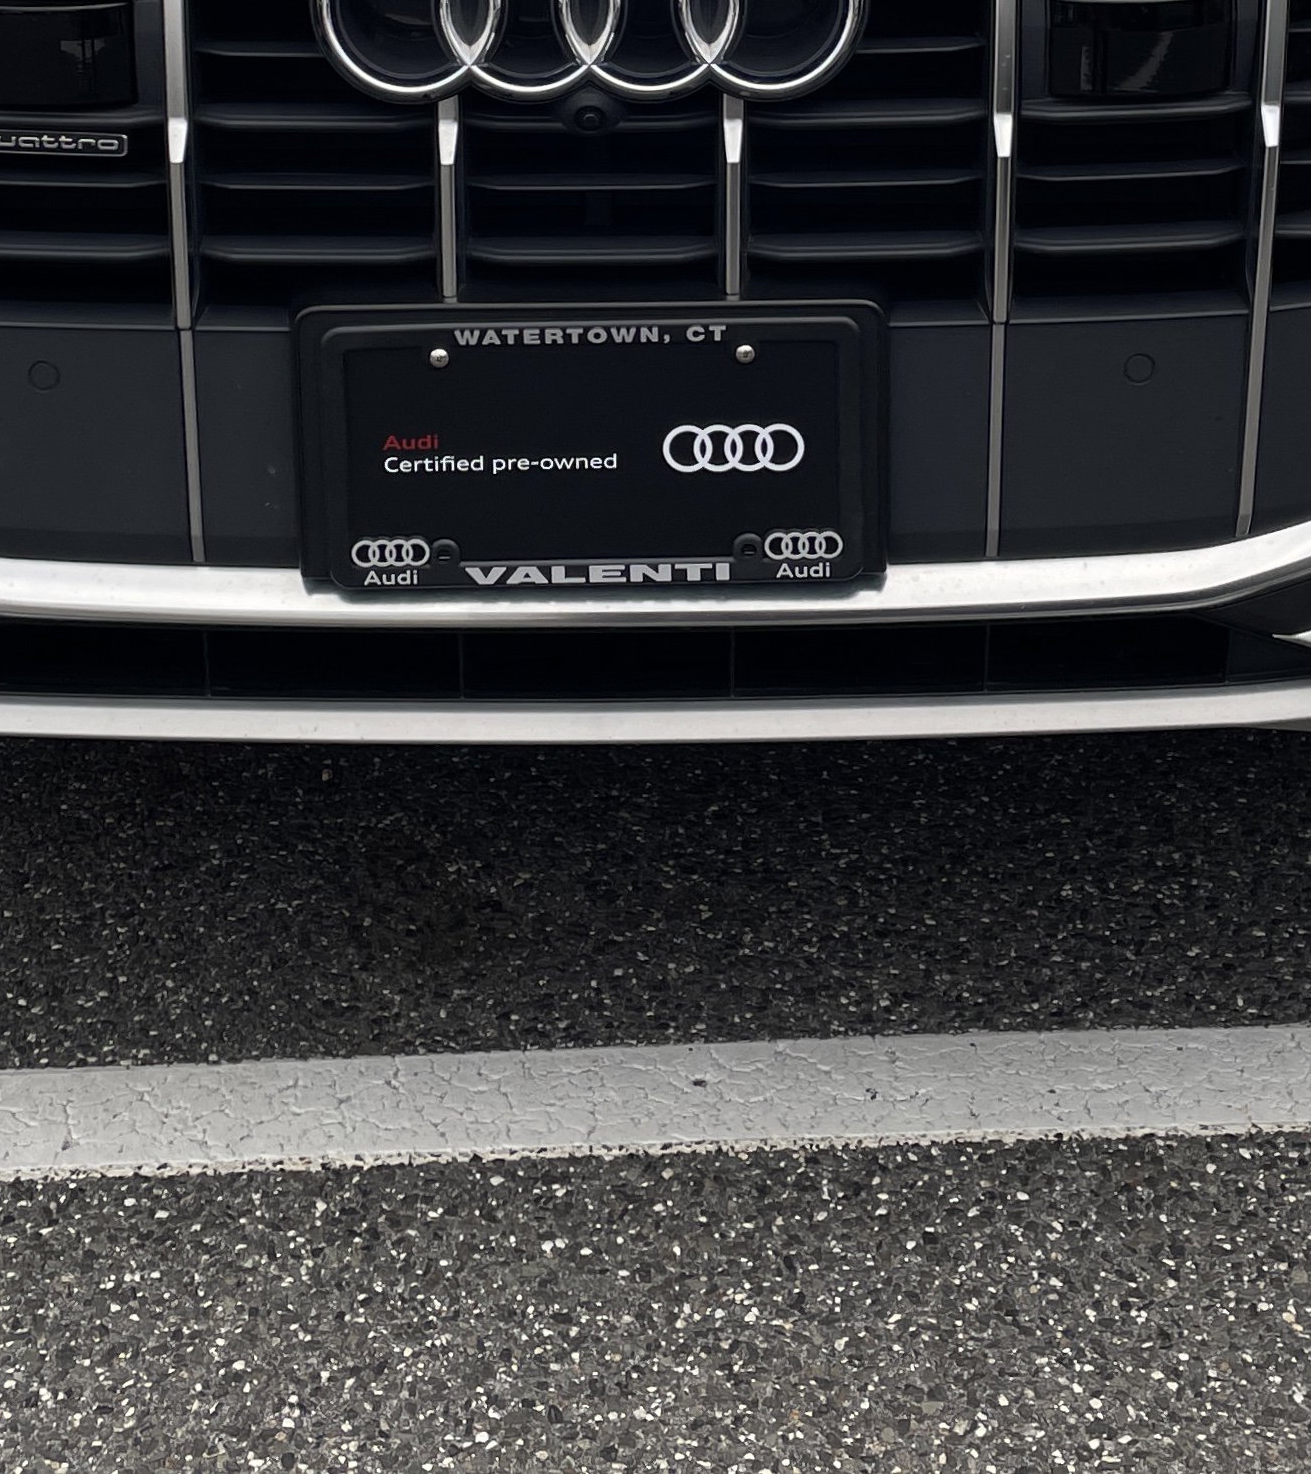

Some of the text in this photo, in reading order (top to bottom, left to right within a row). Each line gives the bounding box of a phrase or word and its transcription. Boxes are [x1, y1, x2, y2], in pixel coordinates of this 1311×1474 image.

[454, 325, 727, 346] WATERTOWN, CT
[383, 434, 439, 450] Audi
[384, 452, 618, 475] Certified pre-owned
[363, 569, 418, 586] Audi
[464, 562, 731, 586] VALENTI
[776, 561, 831, 579] Audi
